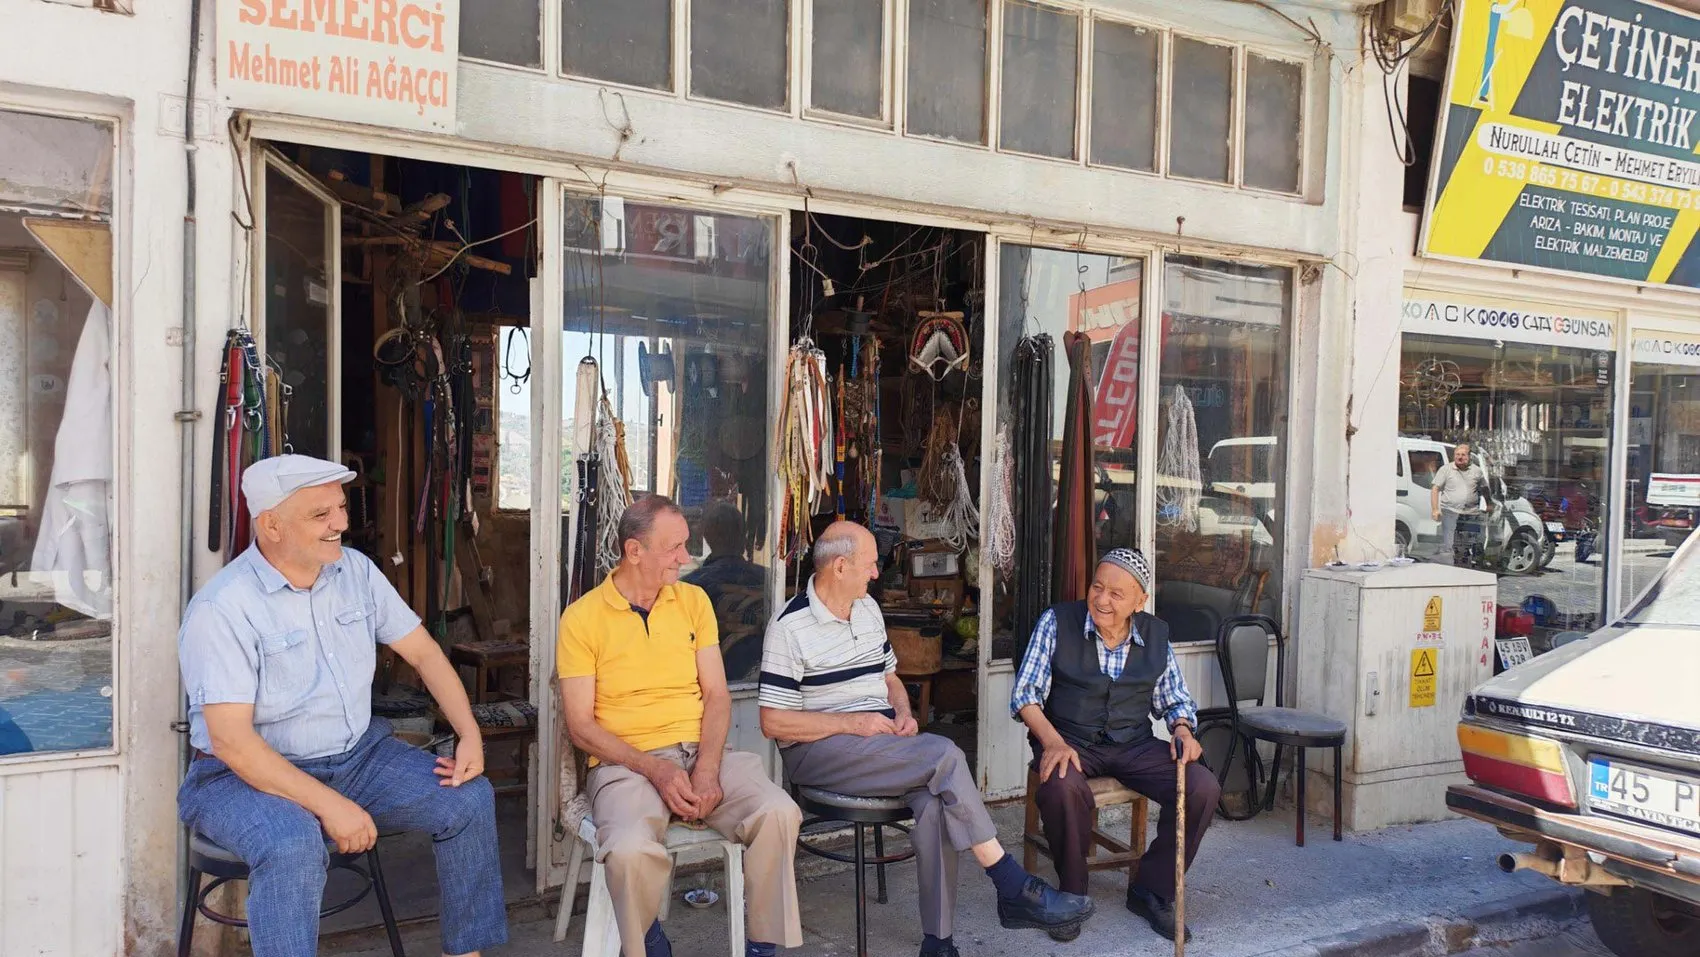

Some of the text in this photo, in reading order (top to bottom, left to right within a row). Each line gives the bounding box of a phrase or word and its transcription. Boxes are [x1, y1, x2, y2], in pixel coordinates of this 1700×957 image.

[239, 0, 445, 52] SEMERCİ
[1555, 5, 1700, 95] ÇETİNER
[229, 40, 449, 116] Mehmet Ali AĞAÇCI
[1557, 80, 1697, 150] ELEKTRİK
[1490, 125, 1560, 160] NURULLAH
[1616, 151, 1664, 179] MEHMET
[1667, 161, 1700, 186] ERYIL
[1484, 157, 1494, 175] 0
[1498, 160, 1525, 180] 538
[1560, 171, 1578, 189] 75
[1581, 176, 1599, 193] 67
[1519, 193, 1566, 214] ELEKTRİK
[1614, 209, 1641, 225] PLAN
[1530, 215, 1561, 232] ARIZA
[1608, 226, 1647, 244] MONTAJ
[1650, 233, 1663, 247] VE
[1535, 234, 1650, 263] ELEKTRİK MALZEMELERİ
[1498, 704, 1576, 727] RENAULT 12 TX
[1594, 781, 1608, 793] TR
[1610, 770, 1649, 803] 45
